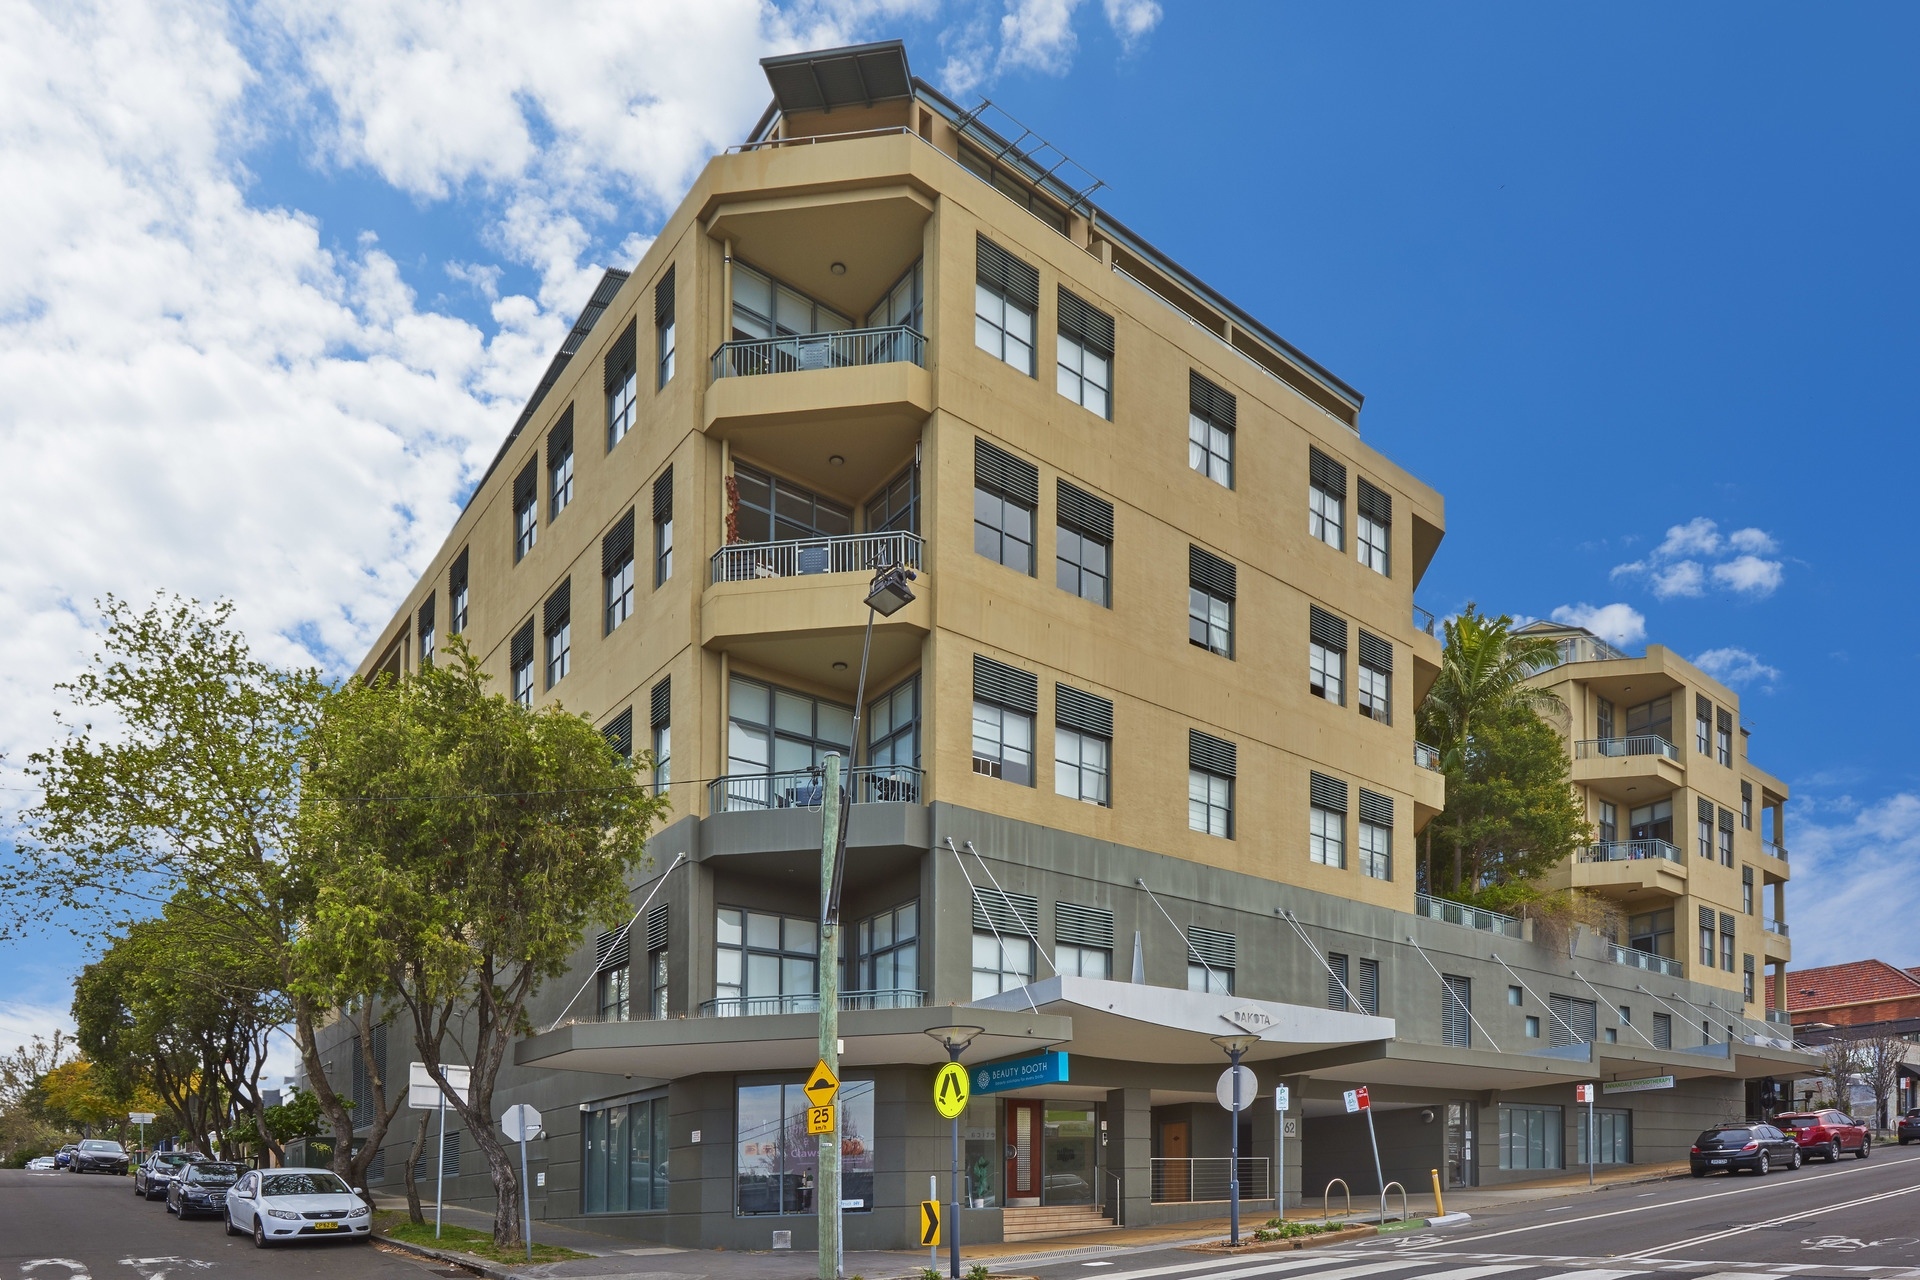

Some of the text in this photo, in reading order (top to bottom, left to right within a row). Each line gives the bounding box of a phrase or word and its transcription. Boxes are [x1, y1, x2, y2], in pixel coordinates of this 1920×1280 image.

[1234, 1011, 1270, 1025] DAKOTA
[993, 1062, 1047, 1080] BEAUTY BOOTH
[813, 1108, 829, 1124] 25
[1284, 1122, 1295, 1134] 62
